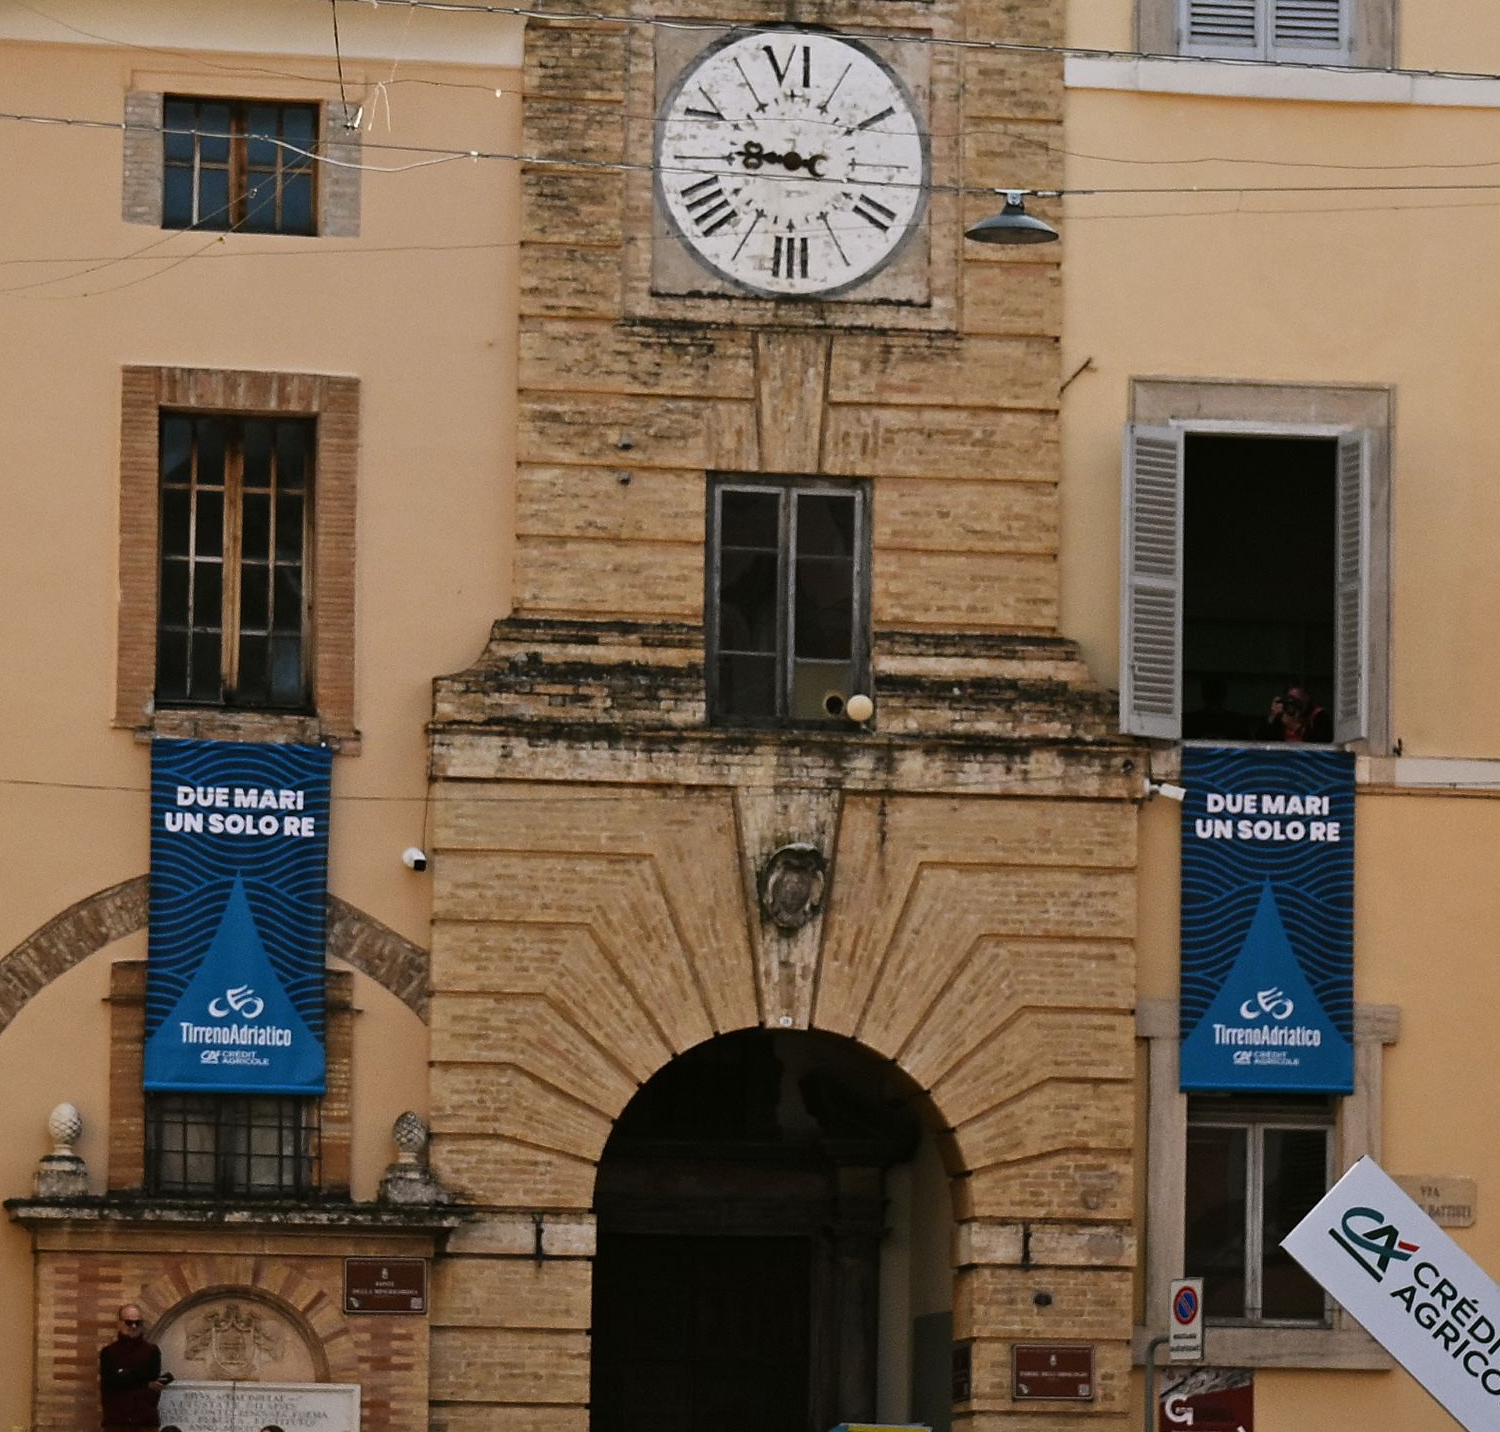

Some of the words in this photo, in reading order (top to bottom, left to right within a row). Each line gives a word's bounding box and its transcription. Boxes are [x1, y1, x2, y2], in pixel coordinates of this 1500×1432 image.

[177, 786, 229, 808] DUE
[234, 788, 305, 810] MARI
[1207, 793, 1257, 814] DUE
[1262, 795, 1330, 816] MARI
[164, 812, 203, 834] UN
[208, 815, 280, 836] SOLO
[283, 817, 316, 838] RE
[1195, 819, 1232, 839] UN
[1237, 820, 1305, 841] SOLO
[1310, 822, 1340, 842] RE
[180, 1022, 292, 1047] TirrenoAdriatico
[1213, 1024, 1321, 1047] TirrenoAdriatico
